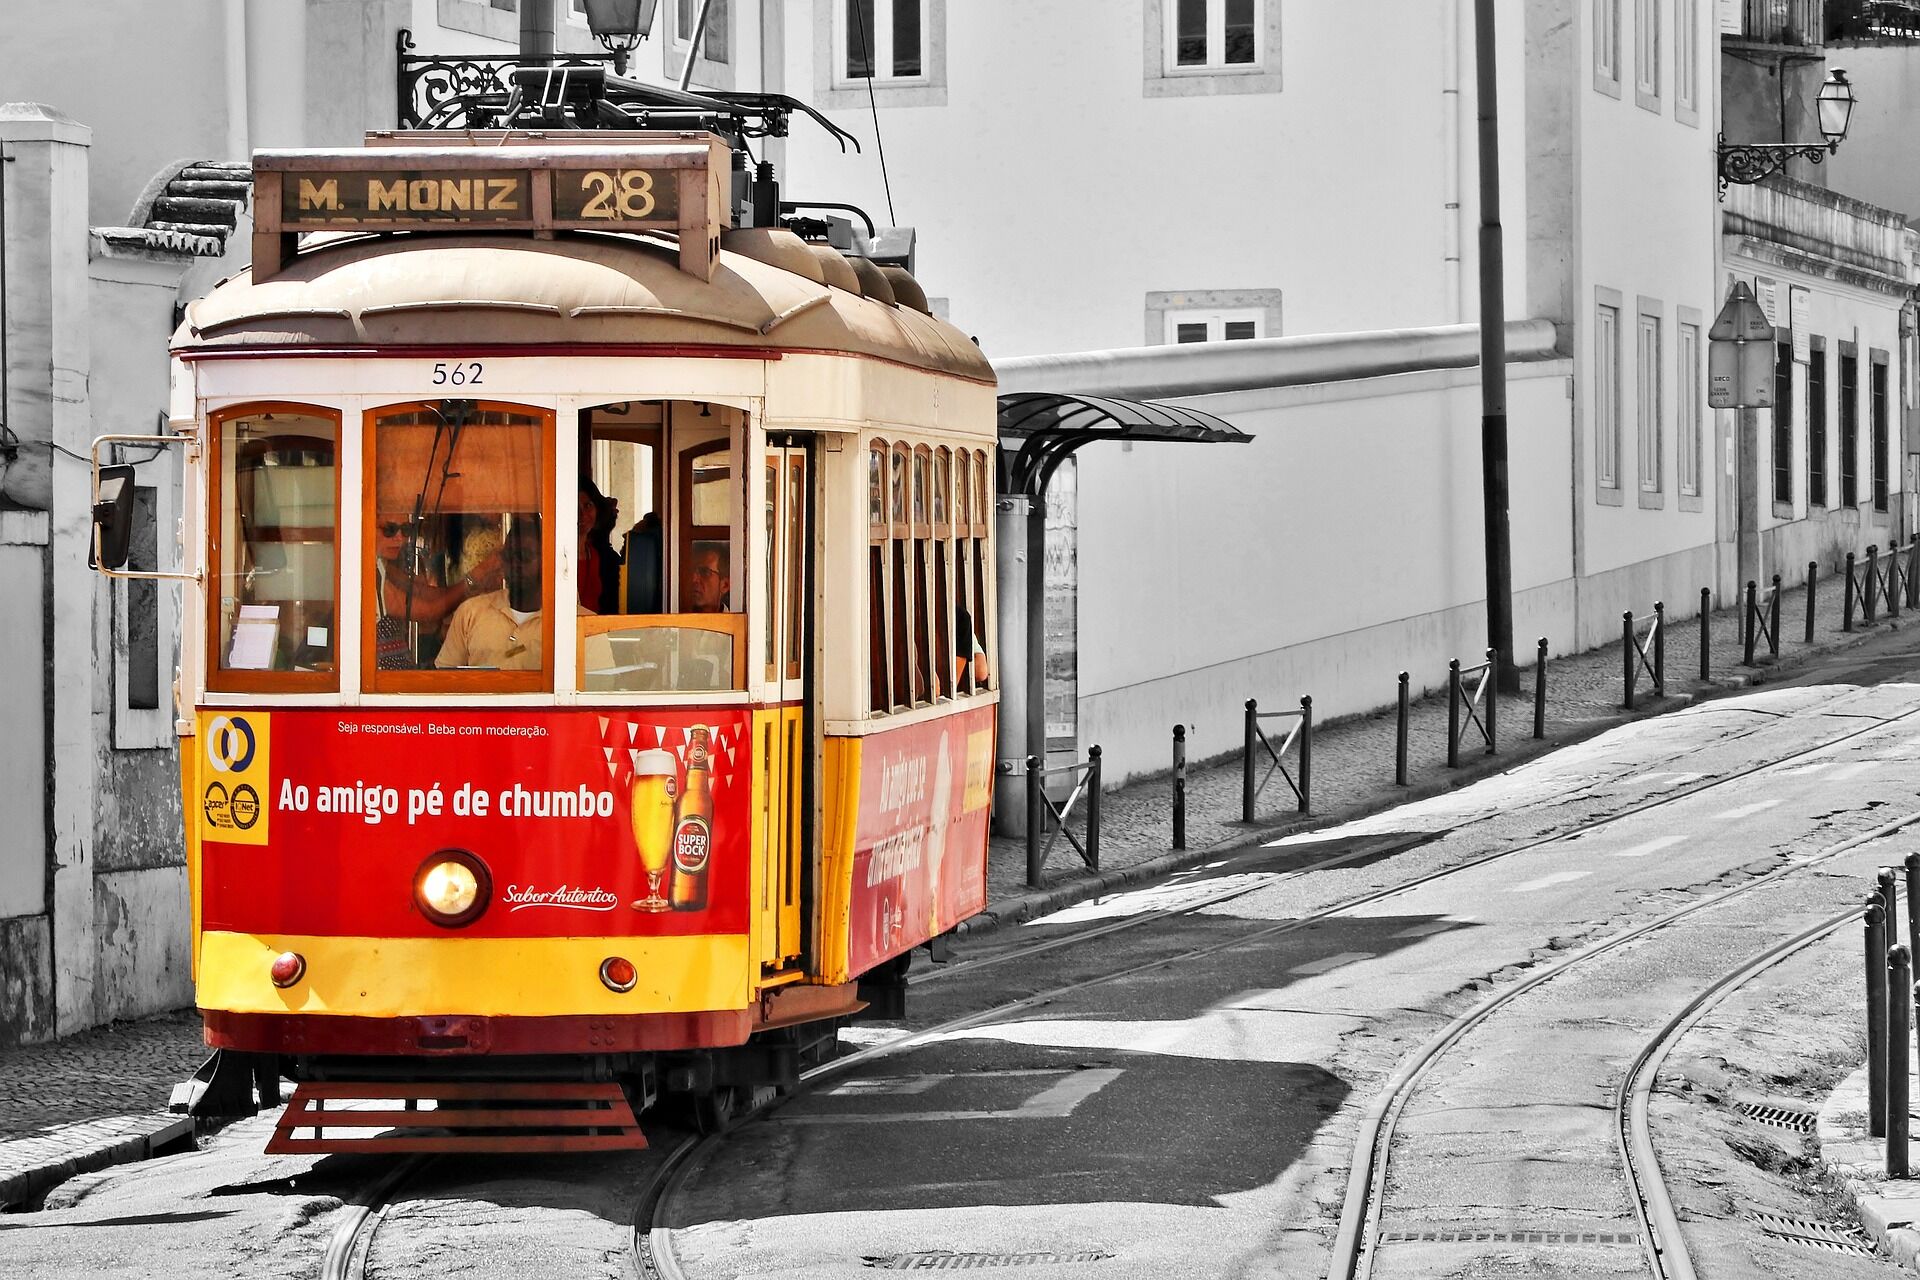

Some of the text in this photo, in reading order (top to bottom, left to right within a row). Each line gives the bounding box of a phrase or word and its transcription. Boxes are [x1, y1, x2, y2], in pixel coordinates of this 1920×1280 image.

[300, 178, 517, 210] M. MONIZ
[581, 169, 655, 220] 28
[432, 362, 484, 387] 562
[338, 721, 549, 739] Seja responsável. Beba com moderação.
[279, 778, 309, 811] Ao
[317, 780, 399, 824] amigo
[409, 782, 443, 825] pé
[453, 783, 490, 816] de
[500, 784, 614, 817] chumbo
[678, 834, 707, 845] SUPER
[678, 845, 705, 857] BOCK
[503, 885, 548, 903] Sabor
